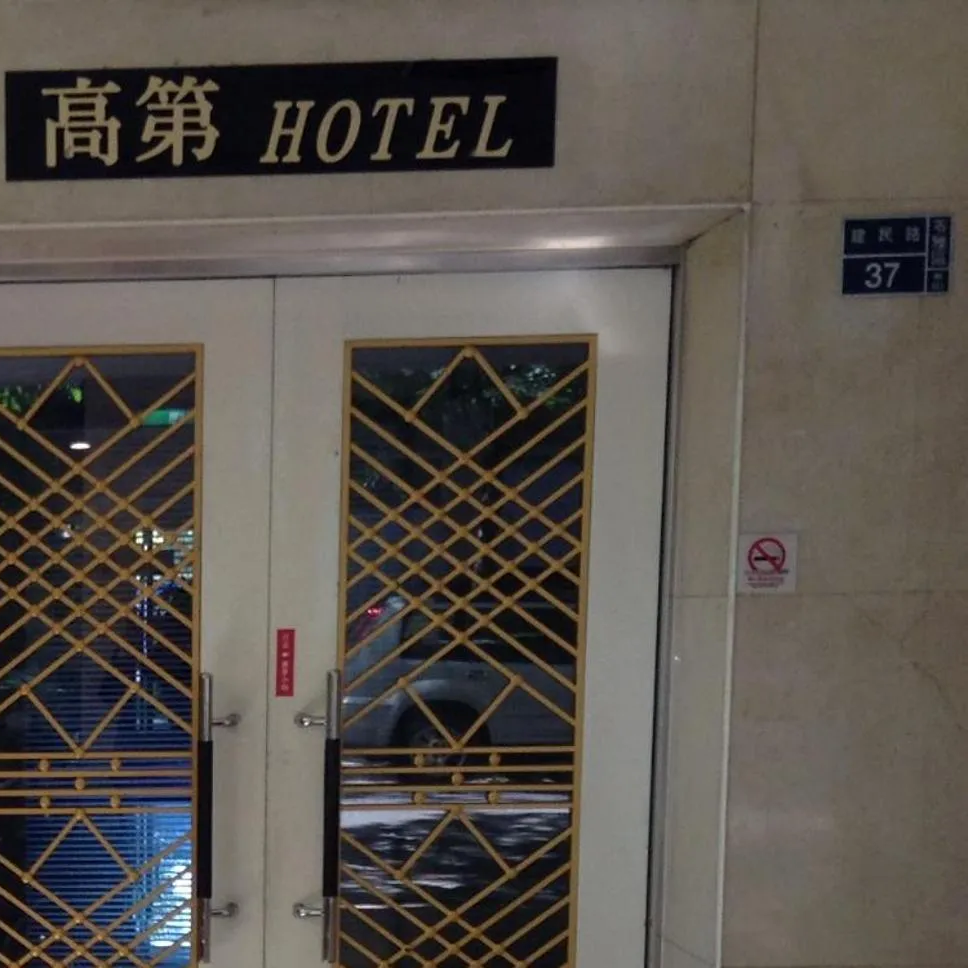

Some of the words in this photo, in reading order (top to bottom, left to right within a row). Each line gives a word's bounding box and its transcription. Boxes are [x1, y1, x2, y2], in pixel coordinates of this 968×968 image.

[41, 75, 220, 167] 高第
[259, 95, 514, 164] HOTEL
[864, 261, 900, 289] 37
